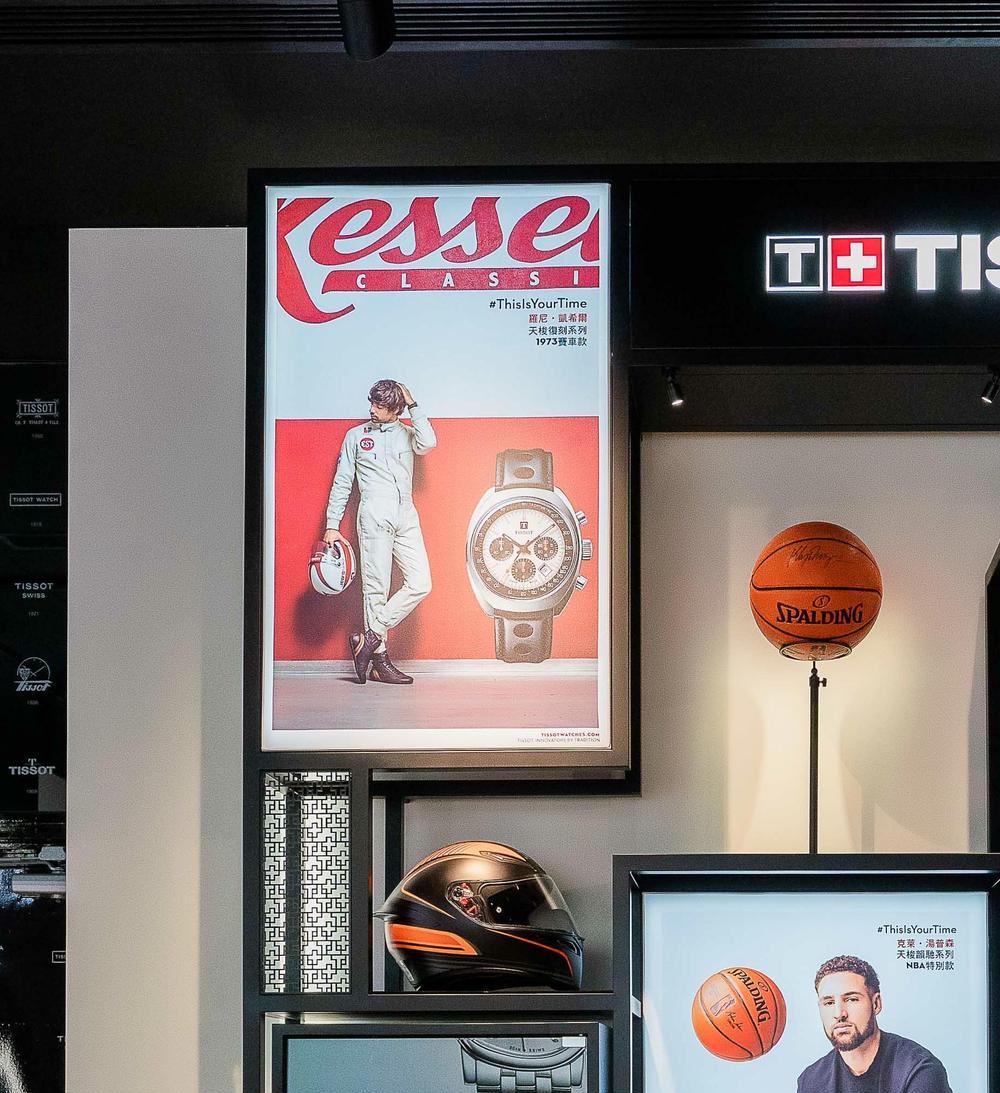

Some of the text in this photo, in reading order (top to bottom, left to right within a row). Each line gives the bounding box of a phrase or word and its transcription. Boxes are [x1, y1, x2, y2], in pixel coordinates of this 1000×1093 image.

[774, 243, 815, 283] T
[355, 271, 580, 290] CLASSI
[489, 297, 588, 310] #ThisIsYourTime
[22, 403, 54, 413] TISSOT
[14, 582, 54, 590] TISSOT
[775, 601, 864, 625] SPALDING
[8, 766, 56, 775] TISSOT
[877, 924, 957, 934] #ThisIsYourTime
[727, 968, 771, 1023] SPALDING
